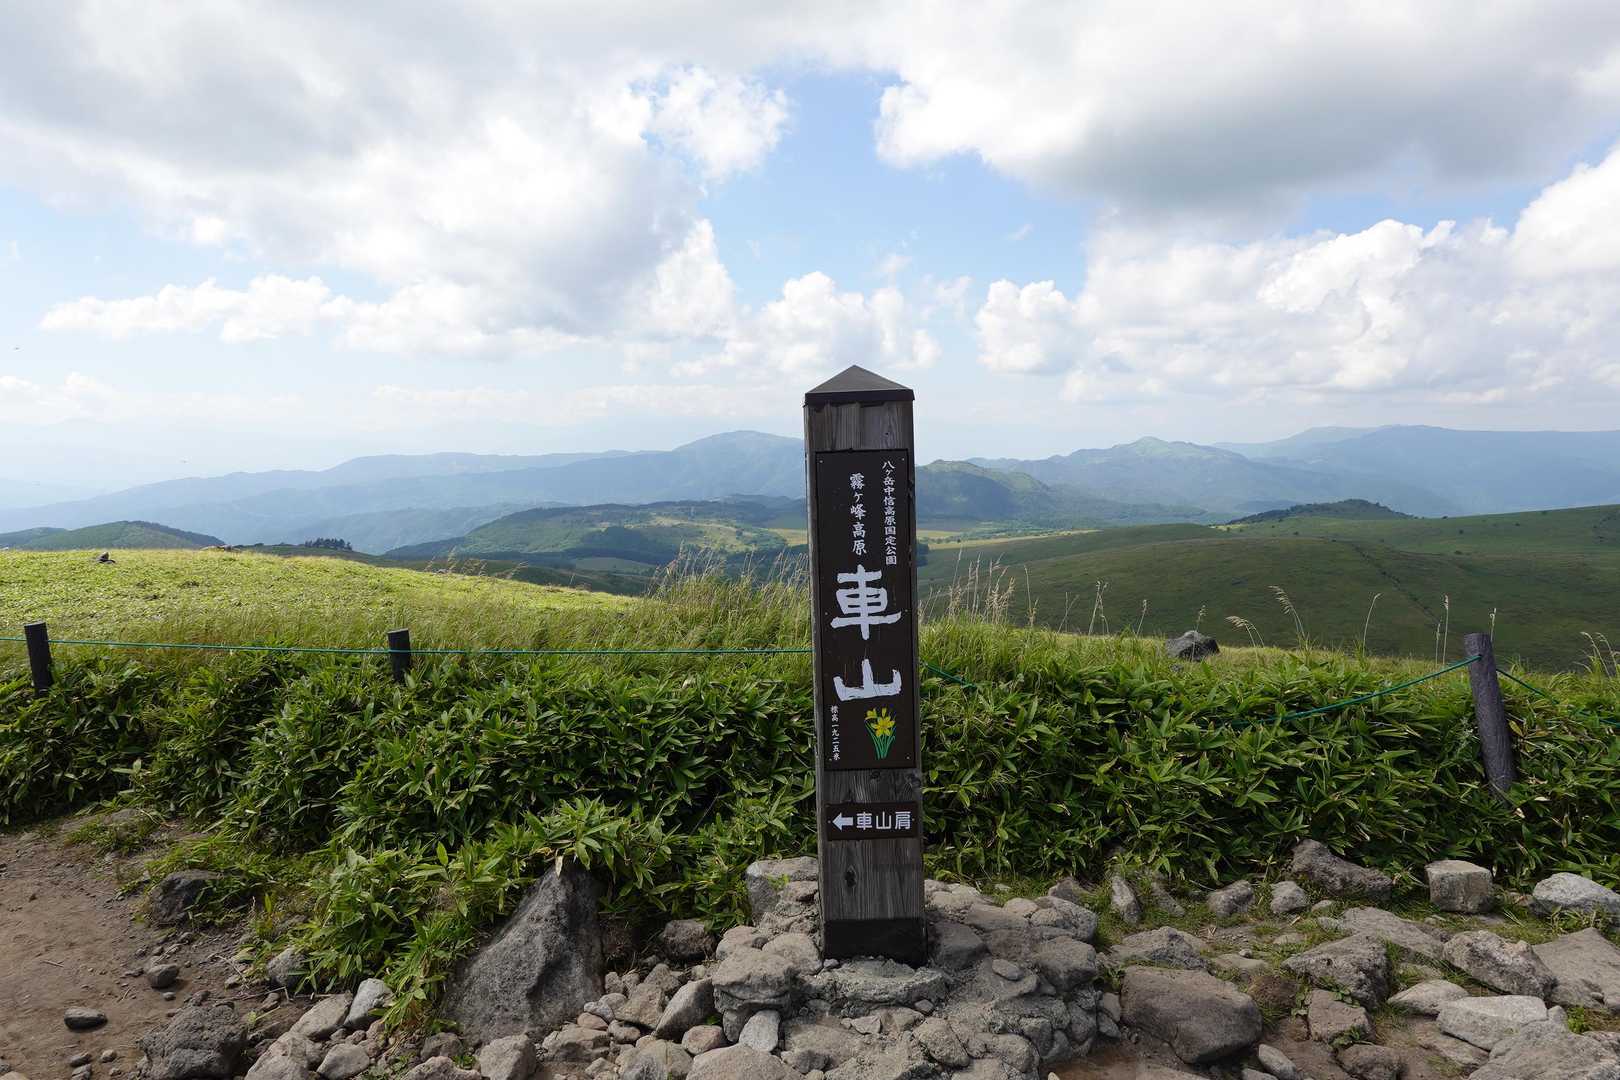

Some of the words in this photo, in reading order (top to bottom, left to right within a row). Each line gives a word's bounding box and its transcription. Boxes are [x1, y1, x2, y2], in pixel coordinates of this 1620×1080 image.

[830, 563, 903, 702] 車山
[856, 811, 912, 830] 車山肩
